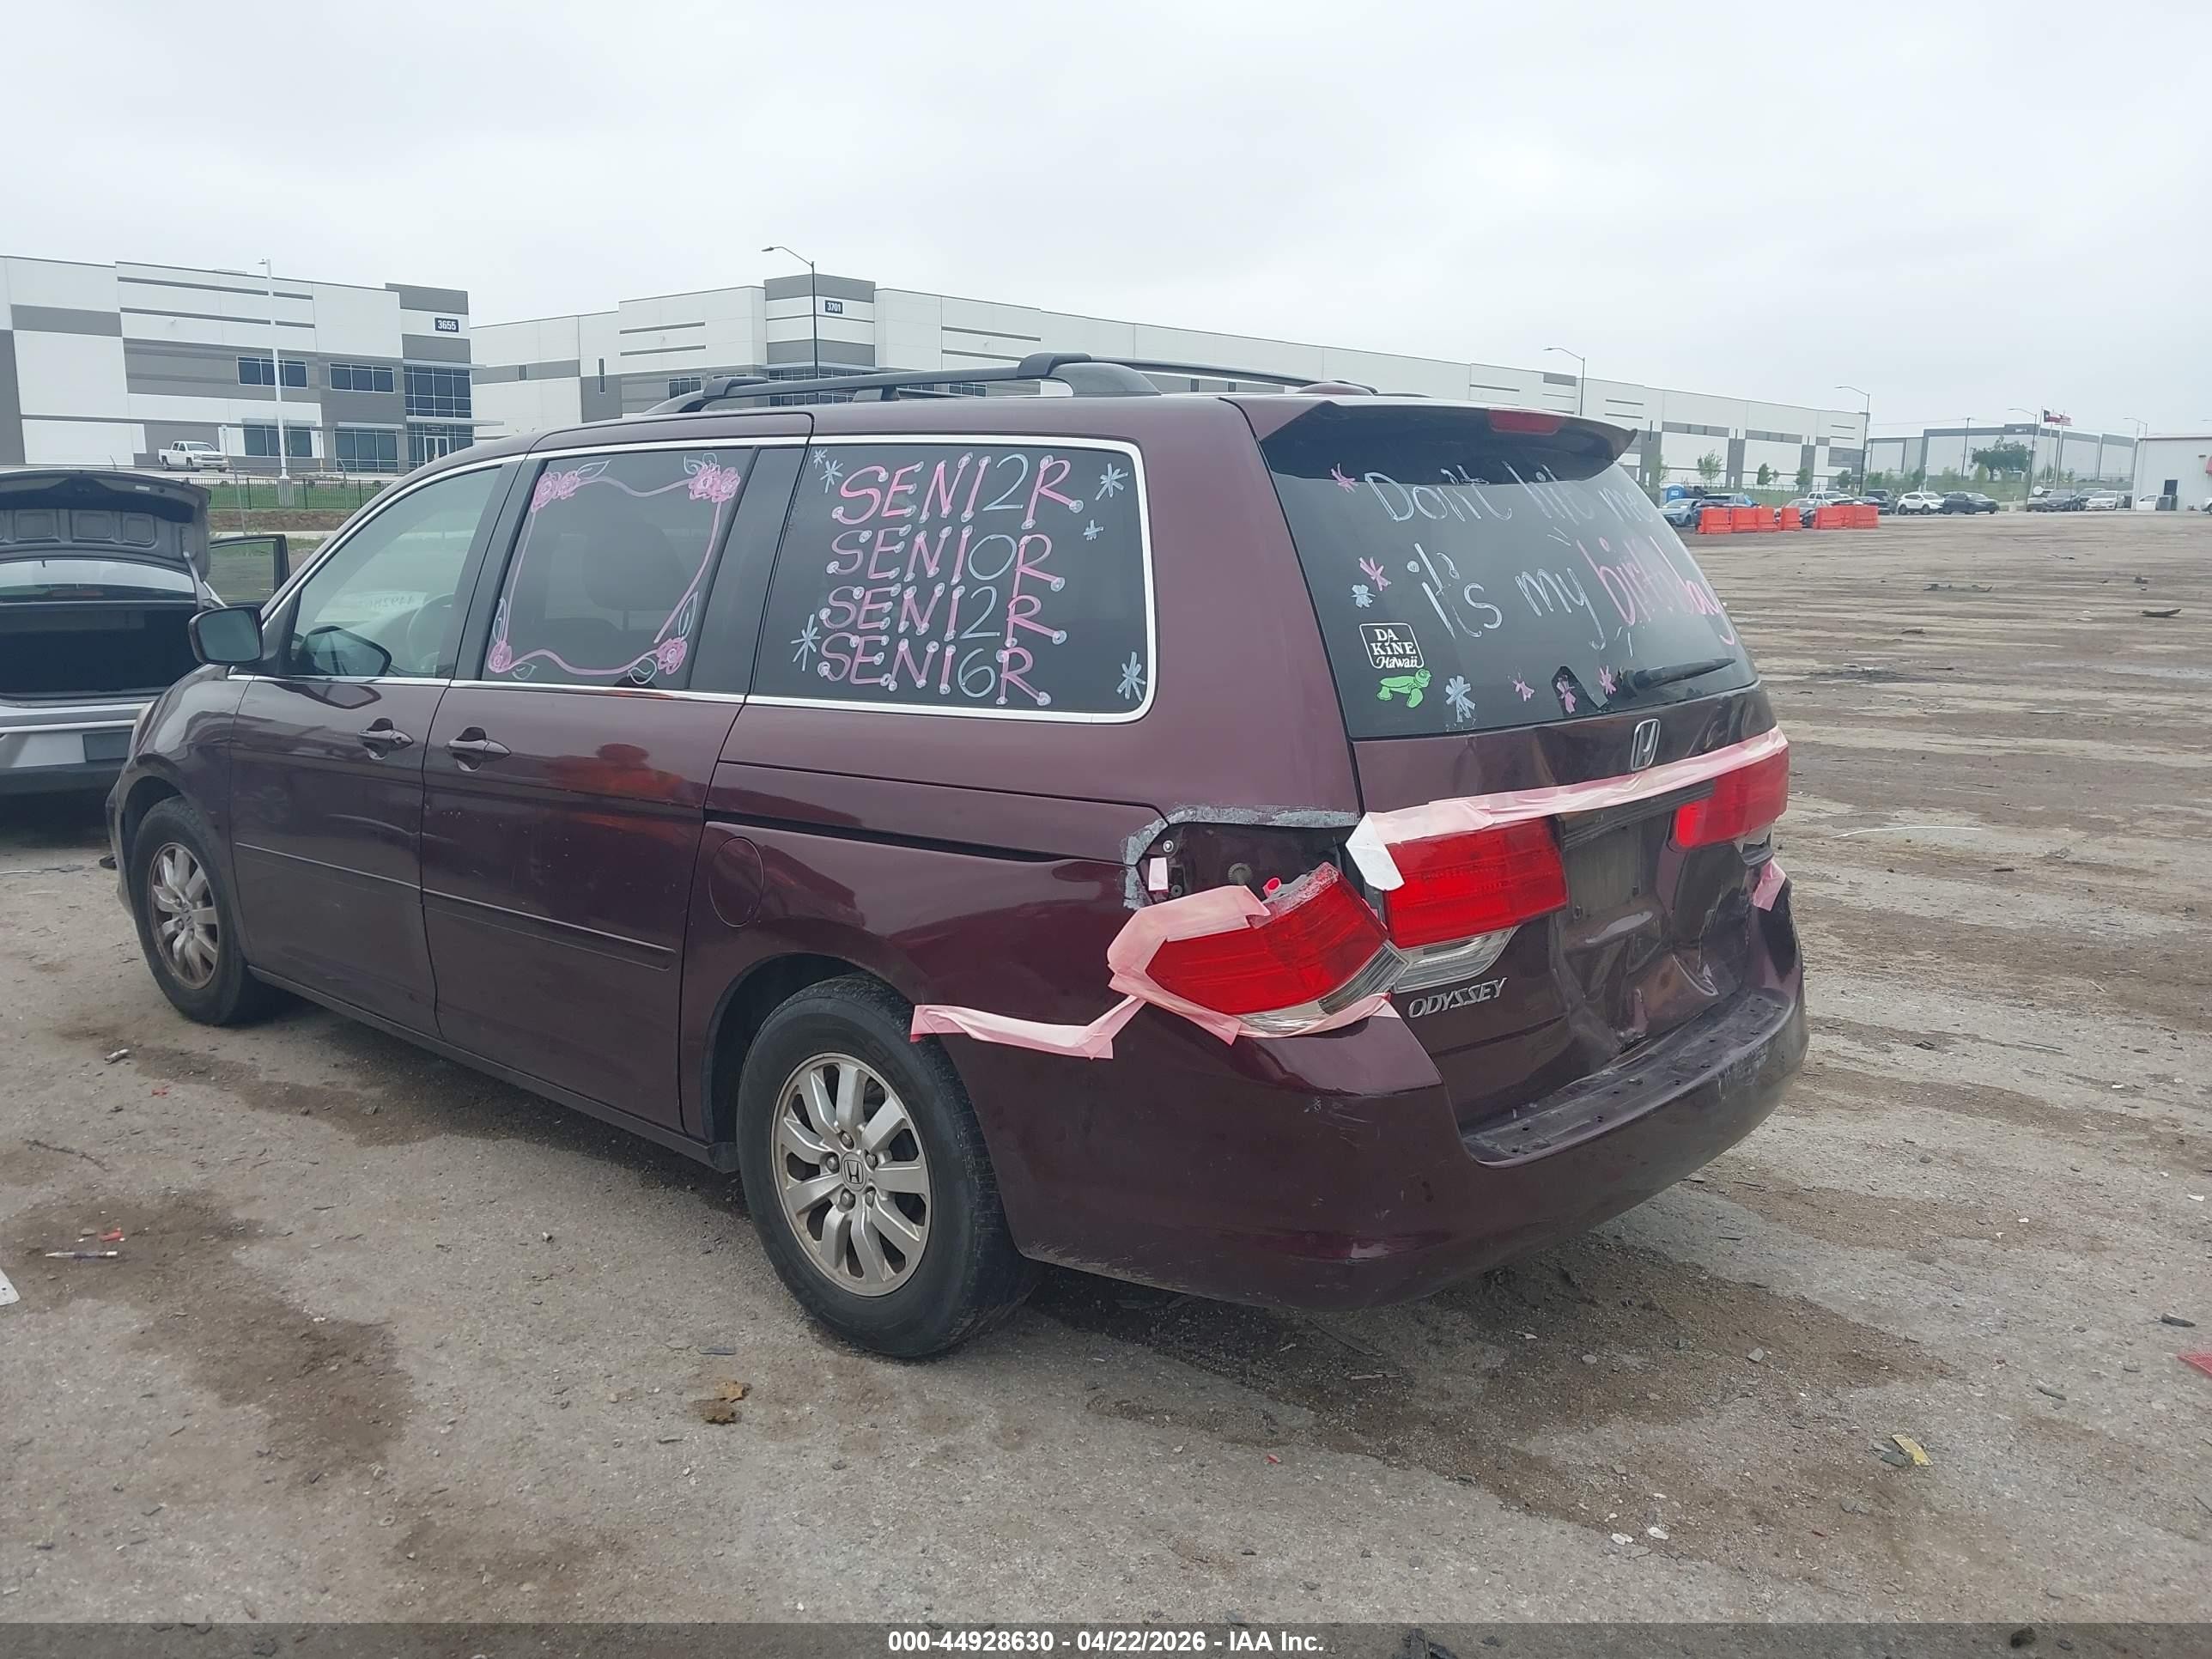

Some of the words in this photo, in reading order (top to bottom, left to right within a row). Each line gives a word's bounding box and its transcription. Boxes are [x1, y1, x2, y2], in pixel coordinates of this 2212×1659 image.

[437, 319, 457, 331] 3655
[827, 301, 841, 313] 3701
[832, 453, 1084, 529] SENI2R
[818, 582, 1067, 648] SENI2R
[1515, 567, 1607, 652] my
[1374, 629, 1400, 646] DA
[817, 632, 1052, 706] SENI6R
[1376, 655, 1419, 669] Hawaii
[1408, 977, 1508, 1018] ODYSSEY
